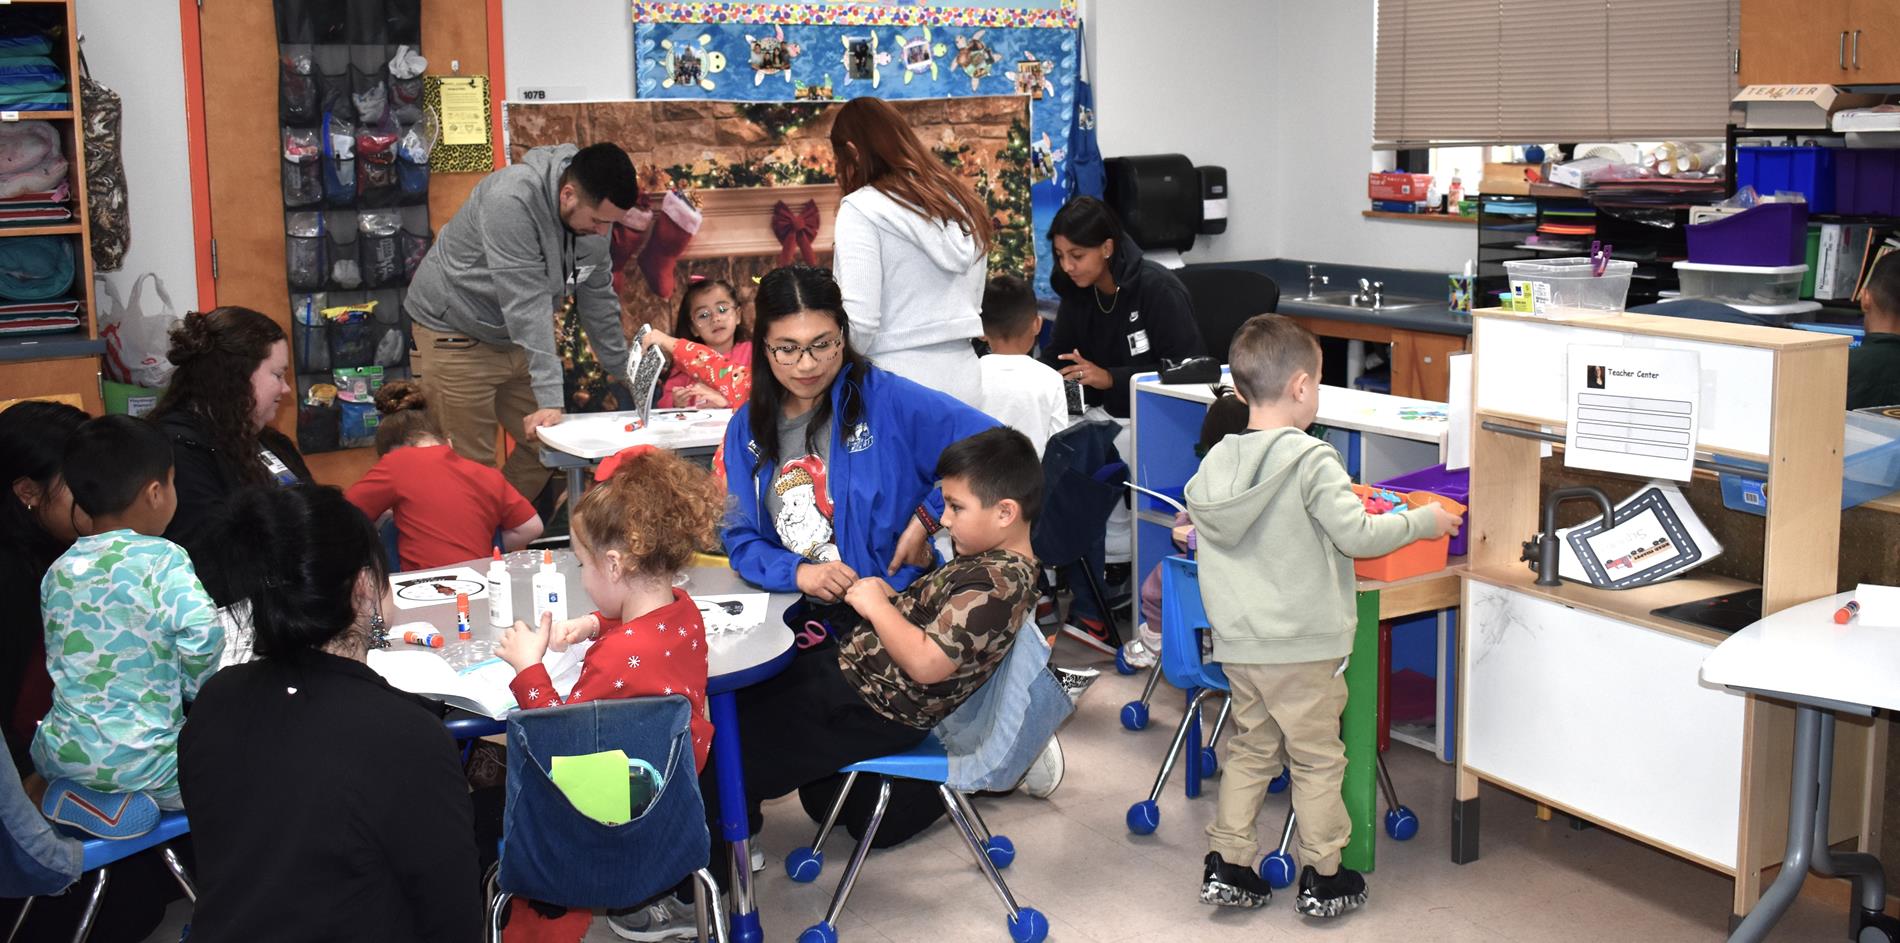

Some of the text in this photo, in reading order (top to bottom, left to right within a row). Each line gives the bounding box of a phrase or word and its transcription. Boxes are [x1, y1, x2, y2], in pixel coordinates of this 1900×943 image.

[523, 90, 545, 99] 107B
[1747, 87, 1818, 95] TEACHER
[1608, 368, 1659, 379] Teacher Center
